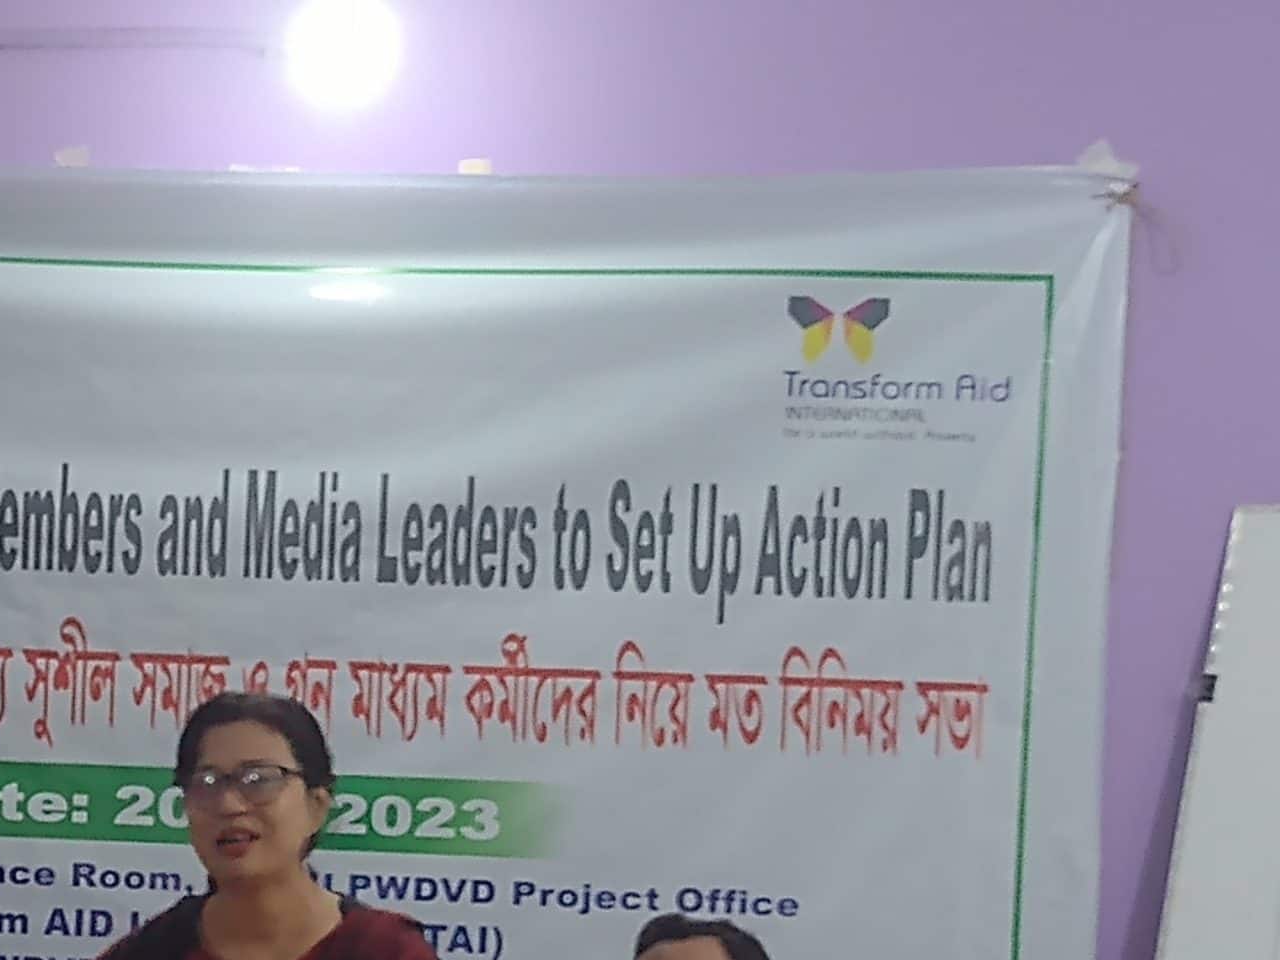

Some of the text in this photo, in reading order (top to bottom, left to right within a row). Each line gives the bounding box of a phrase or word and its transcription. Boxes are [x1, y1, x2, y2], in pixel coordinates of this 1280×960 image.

[784, 370, 1011, 402] Transform Aid
[157, 468, 229, 578] and
[243, 469, 361, 582] Media
[376, 473, 537, 590] Leaders
[553, 482, 591, 591] to
[606, 478, 674, 593] Set
[688, 482, 741, 625] Up
[754, 485, 888, 599] Action
[904, 488, 992, 602] Plan
[23, 616, 121, 748] সুশীল
[348, 656, 452, 742] মাধ্যম
[463, 633, 600, 746] কর্মীদের
[613, 641, 693, 751] নিয়ে
[705, 674, 767, 751] মত
[780, 646, 903, 757] বিনিময়
[916, 677, 988, 760] সভা
[325, 794, 501, 840] 2023
[324, 872, 496, 905] LPWDVD
[512, 880, 659, 915] Project
[676, 886, 799, 917] Office
[44, 908, 113, 938] AID
